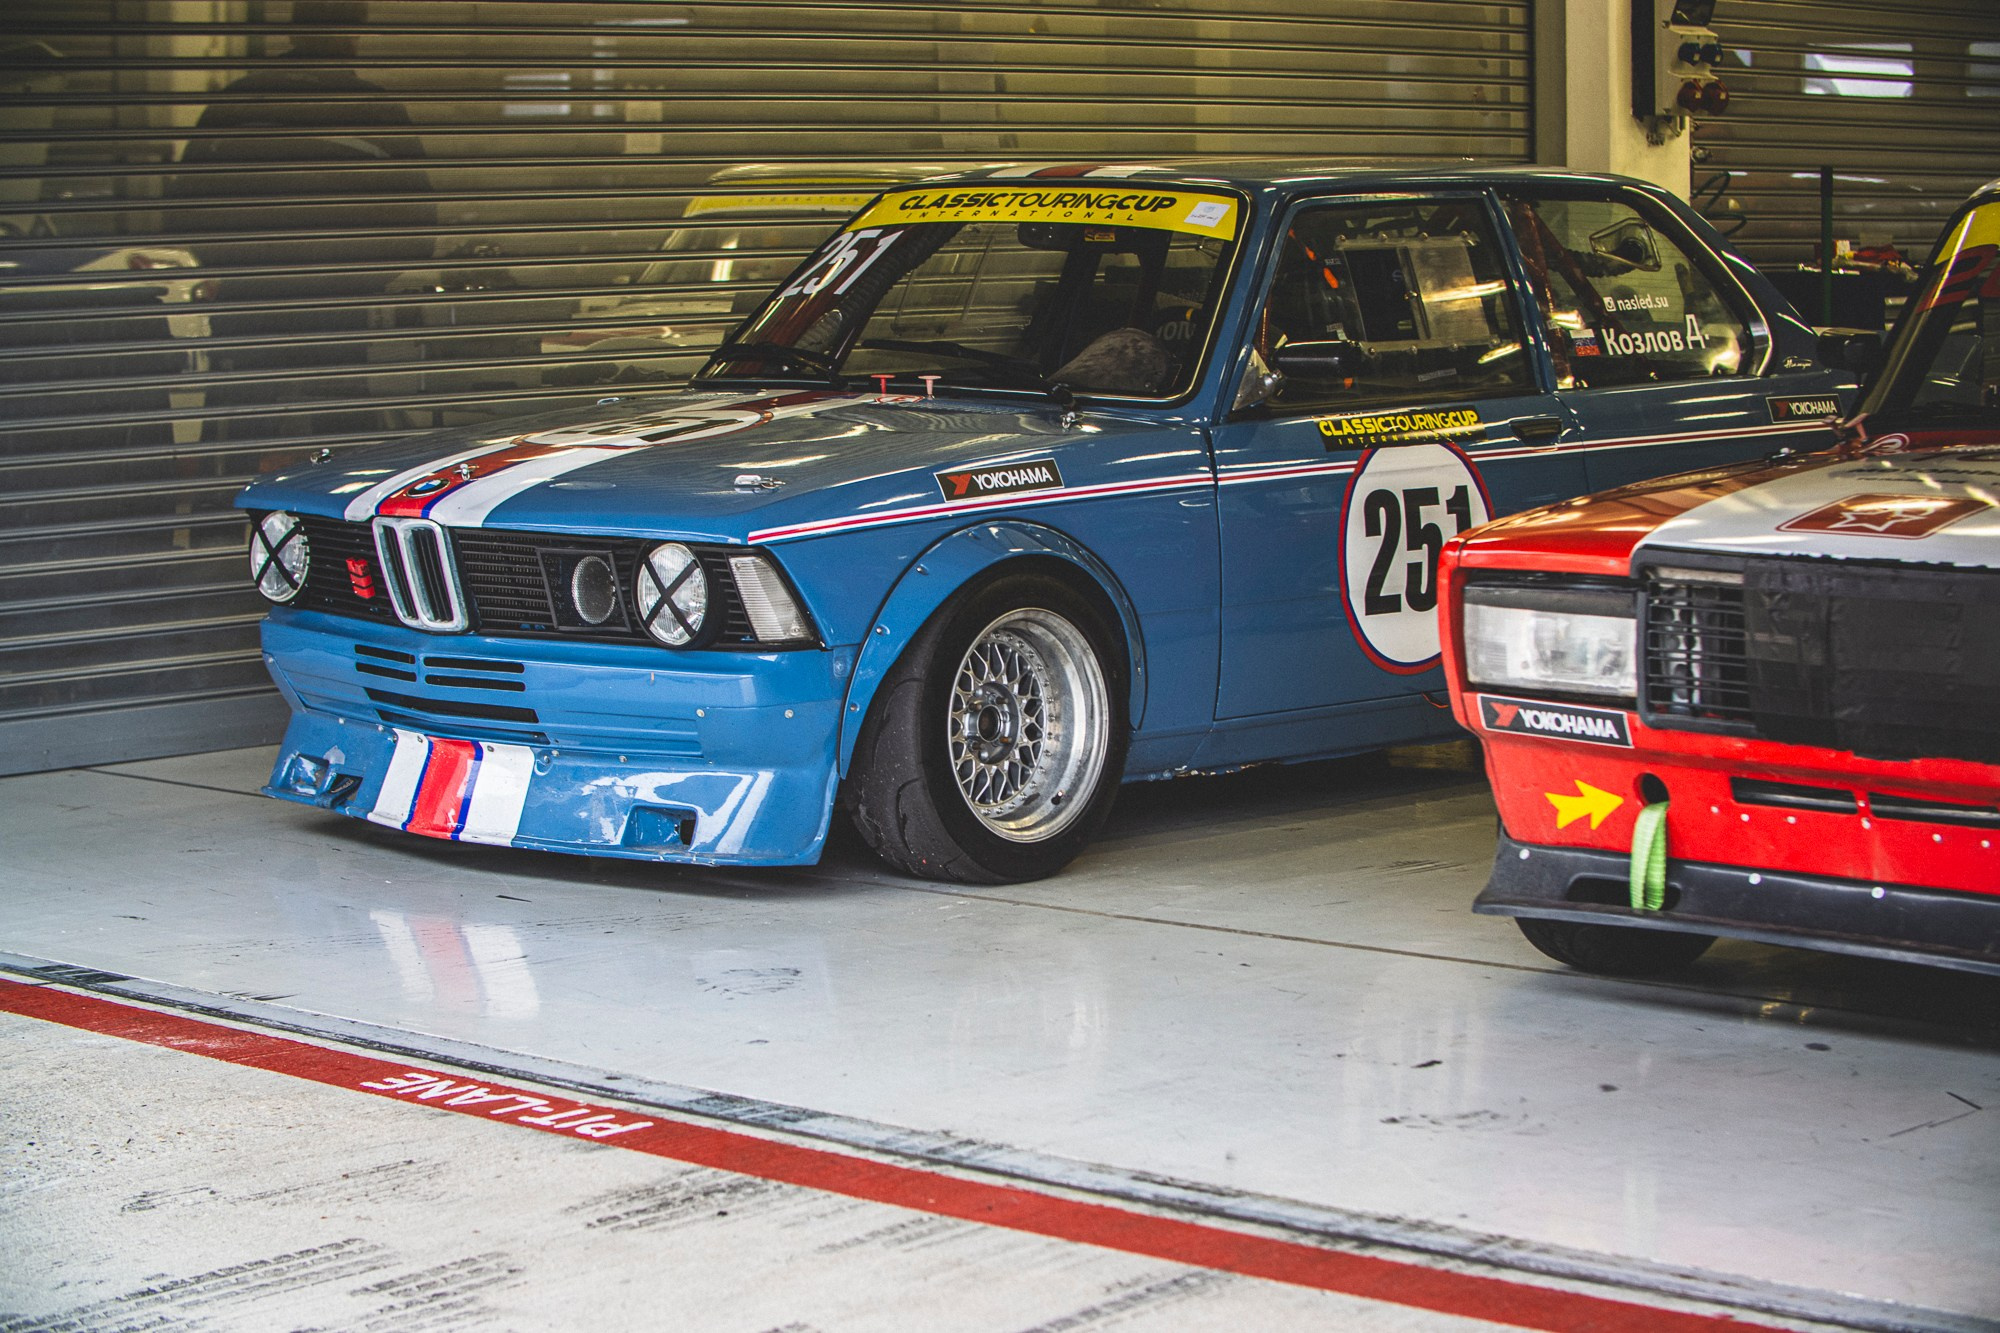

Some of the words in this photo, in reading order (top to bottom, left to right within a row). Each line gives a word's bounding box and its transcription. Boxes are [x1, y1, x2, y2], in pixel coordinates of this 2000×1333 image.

[899, 192, 1178, 213] CLASSICTOURINGCUP
[906, 210, 1135, 221] INTERNATIONAL
[776, 229, 904, 300] 251
[1617, 294, 1669, 311] nasled.su
[1601, 328, 1685, 356] Козлов
[1685, 314, 1710, 349] Д.
[1789, 400, 1838, 415] YOKOHAMA
[1318, 410, 1479, 437] CLASSICTOURINGCUP
[972, 466, 1054, 491] YOKOHAMA
[1518, 708, 1620, 740] YOKOHAMA
[360, 1072, 654, 1138] PIT-LANE
